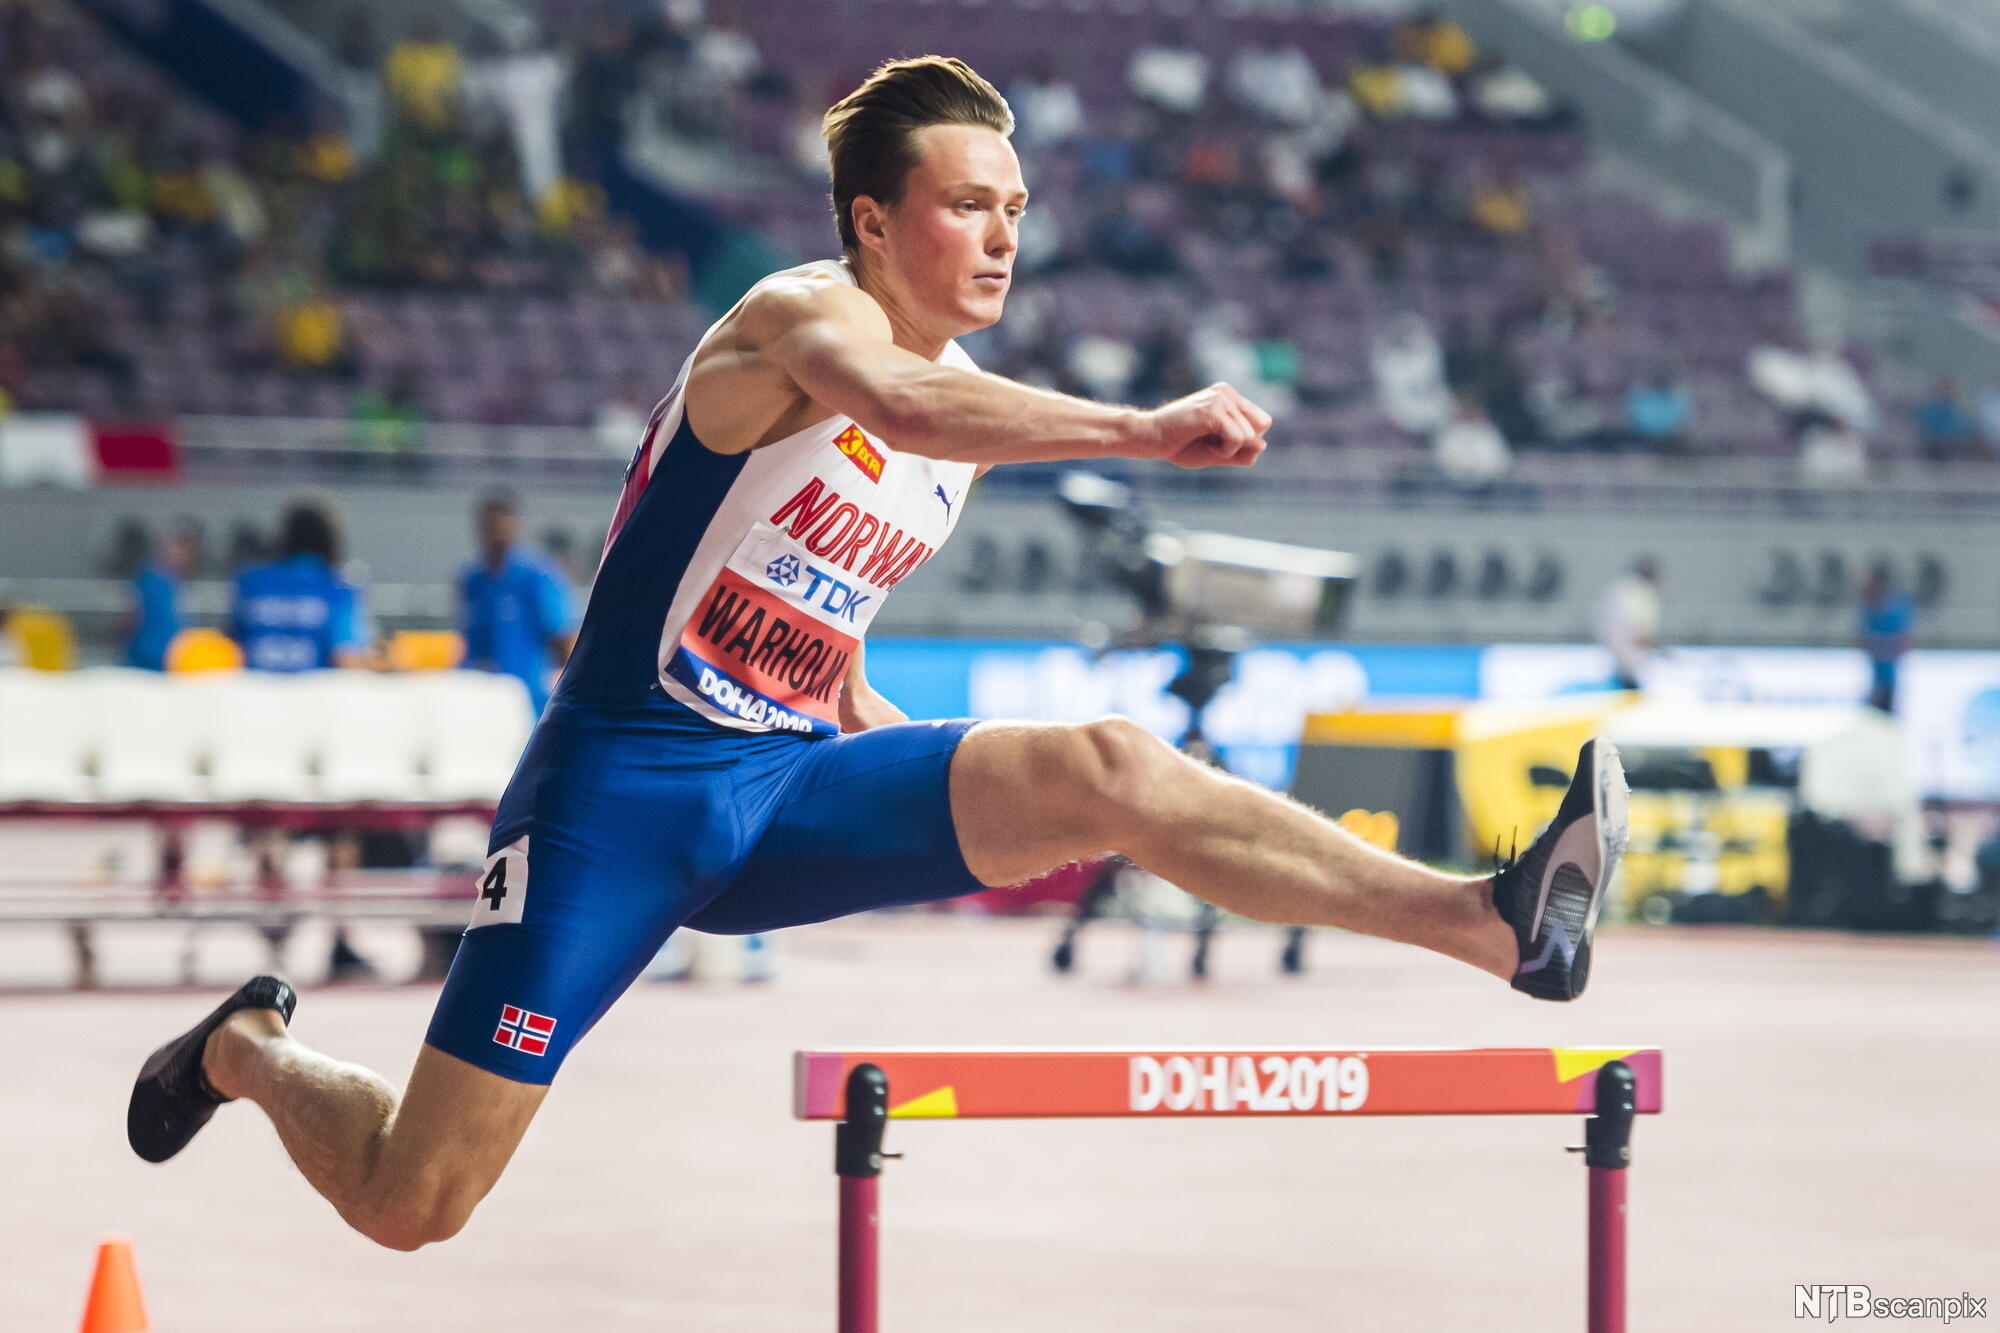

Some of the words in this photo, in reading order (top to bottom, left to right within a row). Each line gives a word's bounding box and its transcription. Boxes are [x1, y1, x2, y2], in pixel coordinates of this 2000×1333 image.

[769, 476, 934, 589] NORWA
[803, 564, 871, 624] TDK
[697, 584, 849, 704] WARHOLM
[481, 857, 508, 912] 4
[1128, 1054, 1370, 1112] DOHA2019
